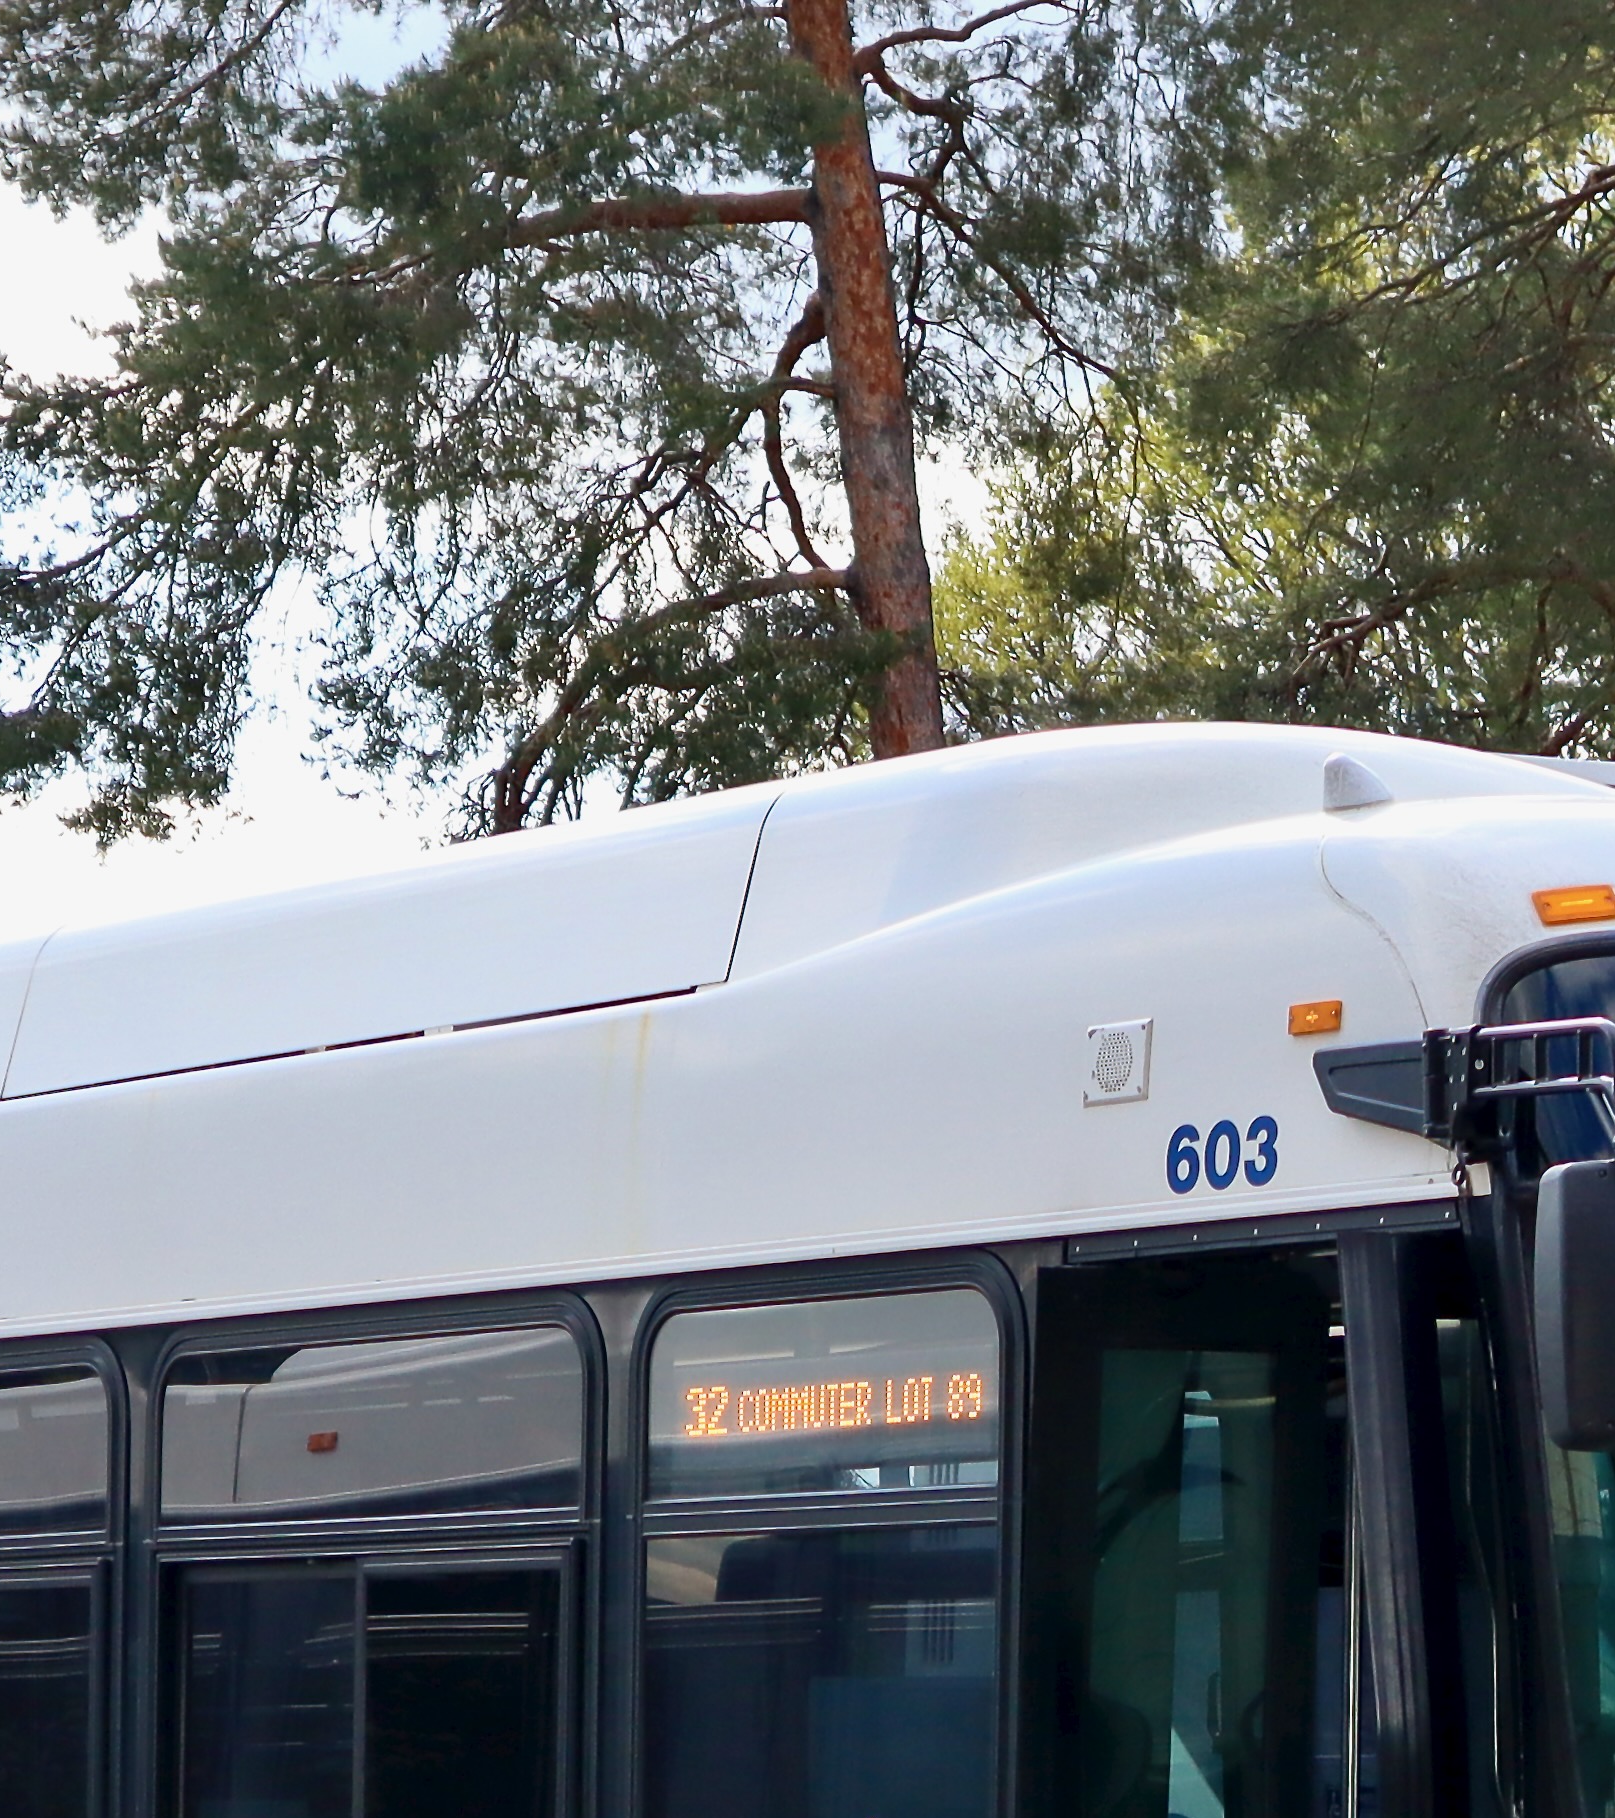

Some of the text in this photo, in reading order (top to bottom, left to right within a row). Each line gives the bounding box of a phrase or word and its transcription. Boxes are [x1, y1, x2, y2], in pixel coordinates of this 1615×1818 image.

[1166, 1115, 1279, 1195] 603
[685, 1373, 982, 1436] 32 COMMUTER LOT 89
